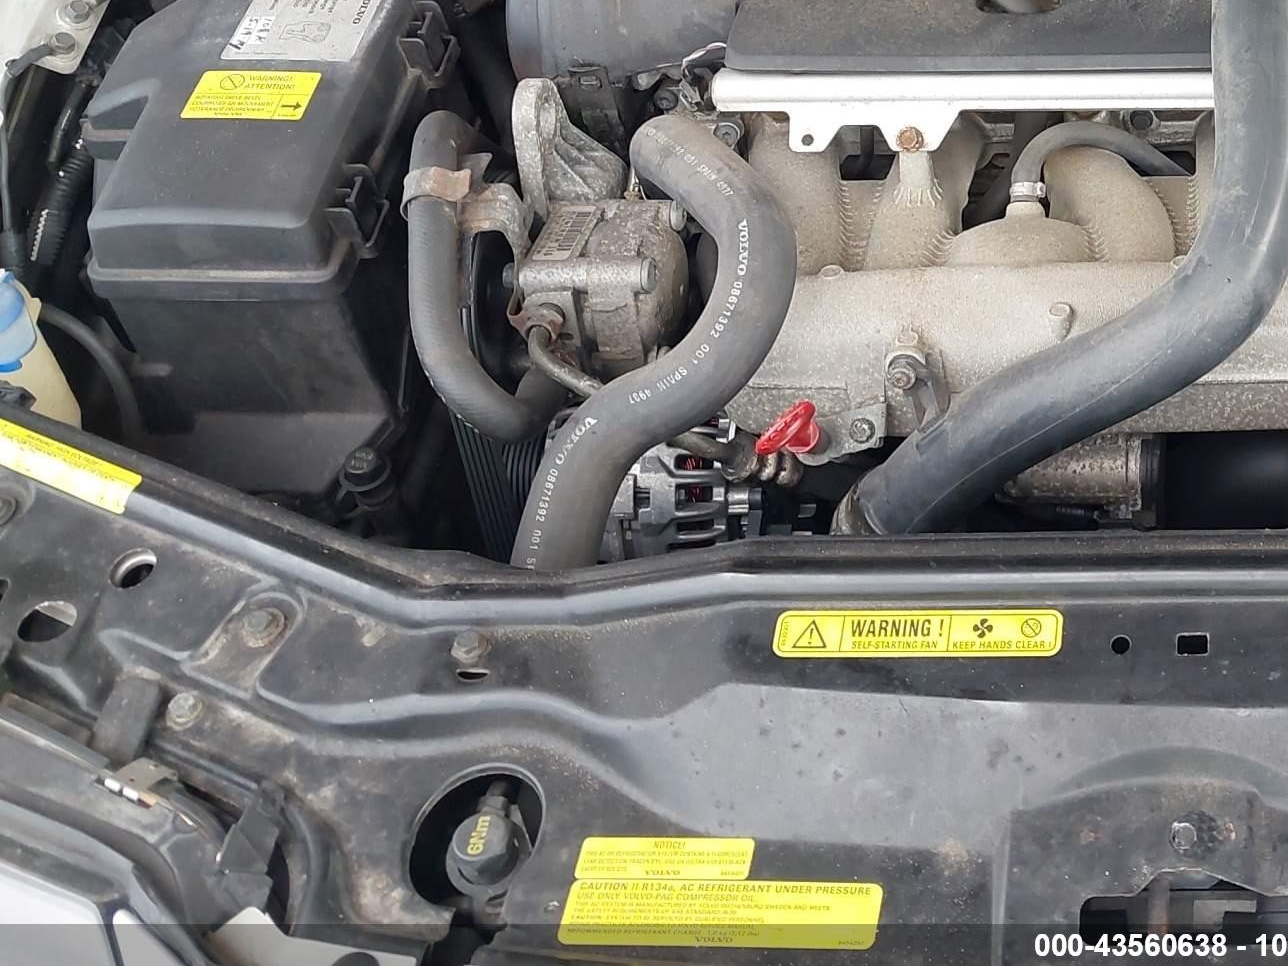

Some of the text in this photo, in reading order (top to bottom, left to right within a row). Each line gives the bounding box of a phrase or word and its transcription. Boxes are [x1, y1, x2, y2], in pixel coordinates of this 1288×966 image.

[628, 218, 750, 404] VOLVO 08671392 001 SPAIN 4937
[529, 416, 599, 550] VOLVO 08671392 001
[850, 619, 932, 638] WARNING
[851, 640, 938, 650] SELF-STARTING FAN
[952, 641, 976, 650] KEEP
[979, 640, 1012, 650] HANDS
[1015, 640, 1046, 649] CLEAR
[652, 841, 686, 850] NOTICE!
[580, 882, 627, 891] CAUTION
[679, 883, 695, 892] AC
[698, 883, 772, 894] REFRIGERANT
[775, 885, 812, 894] UNDER
[815, 886, 872, 896] PRESSURE
[577, 892, 592, 900] USE
[597, 892, 620, 900] ONLY
[675, 893, 739, 902] COMPRESSOR
[695, 936, 733, 944] VOLVO
